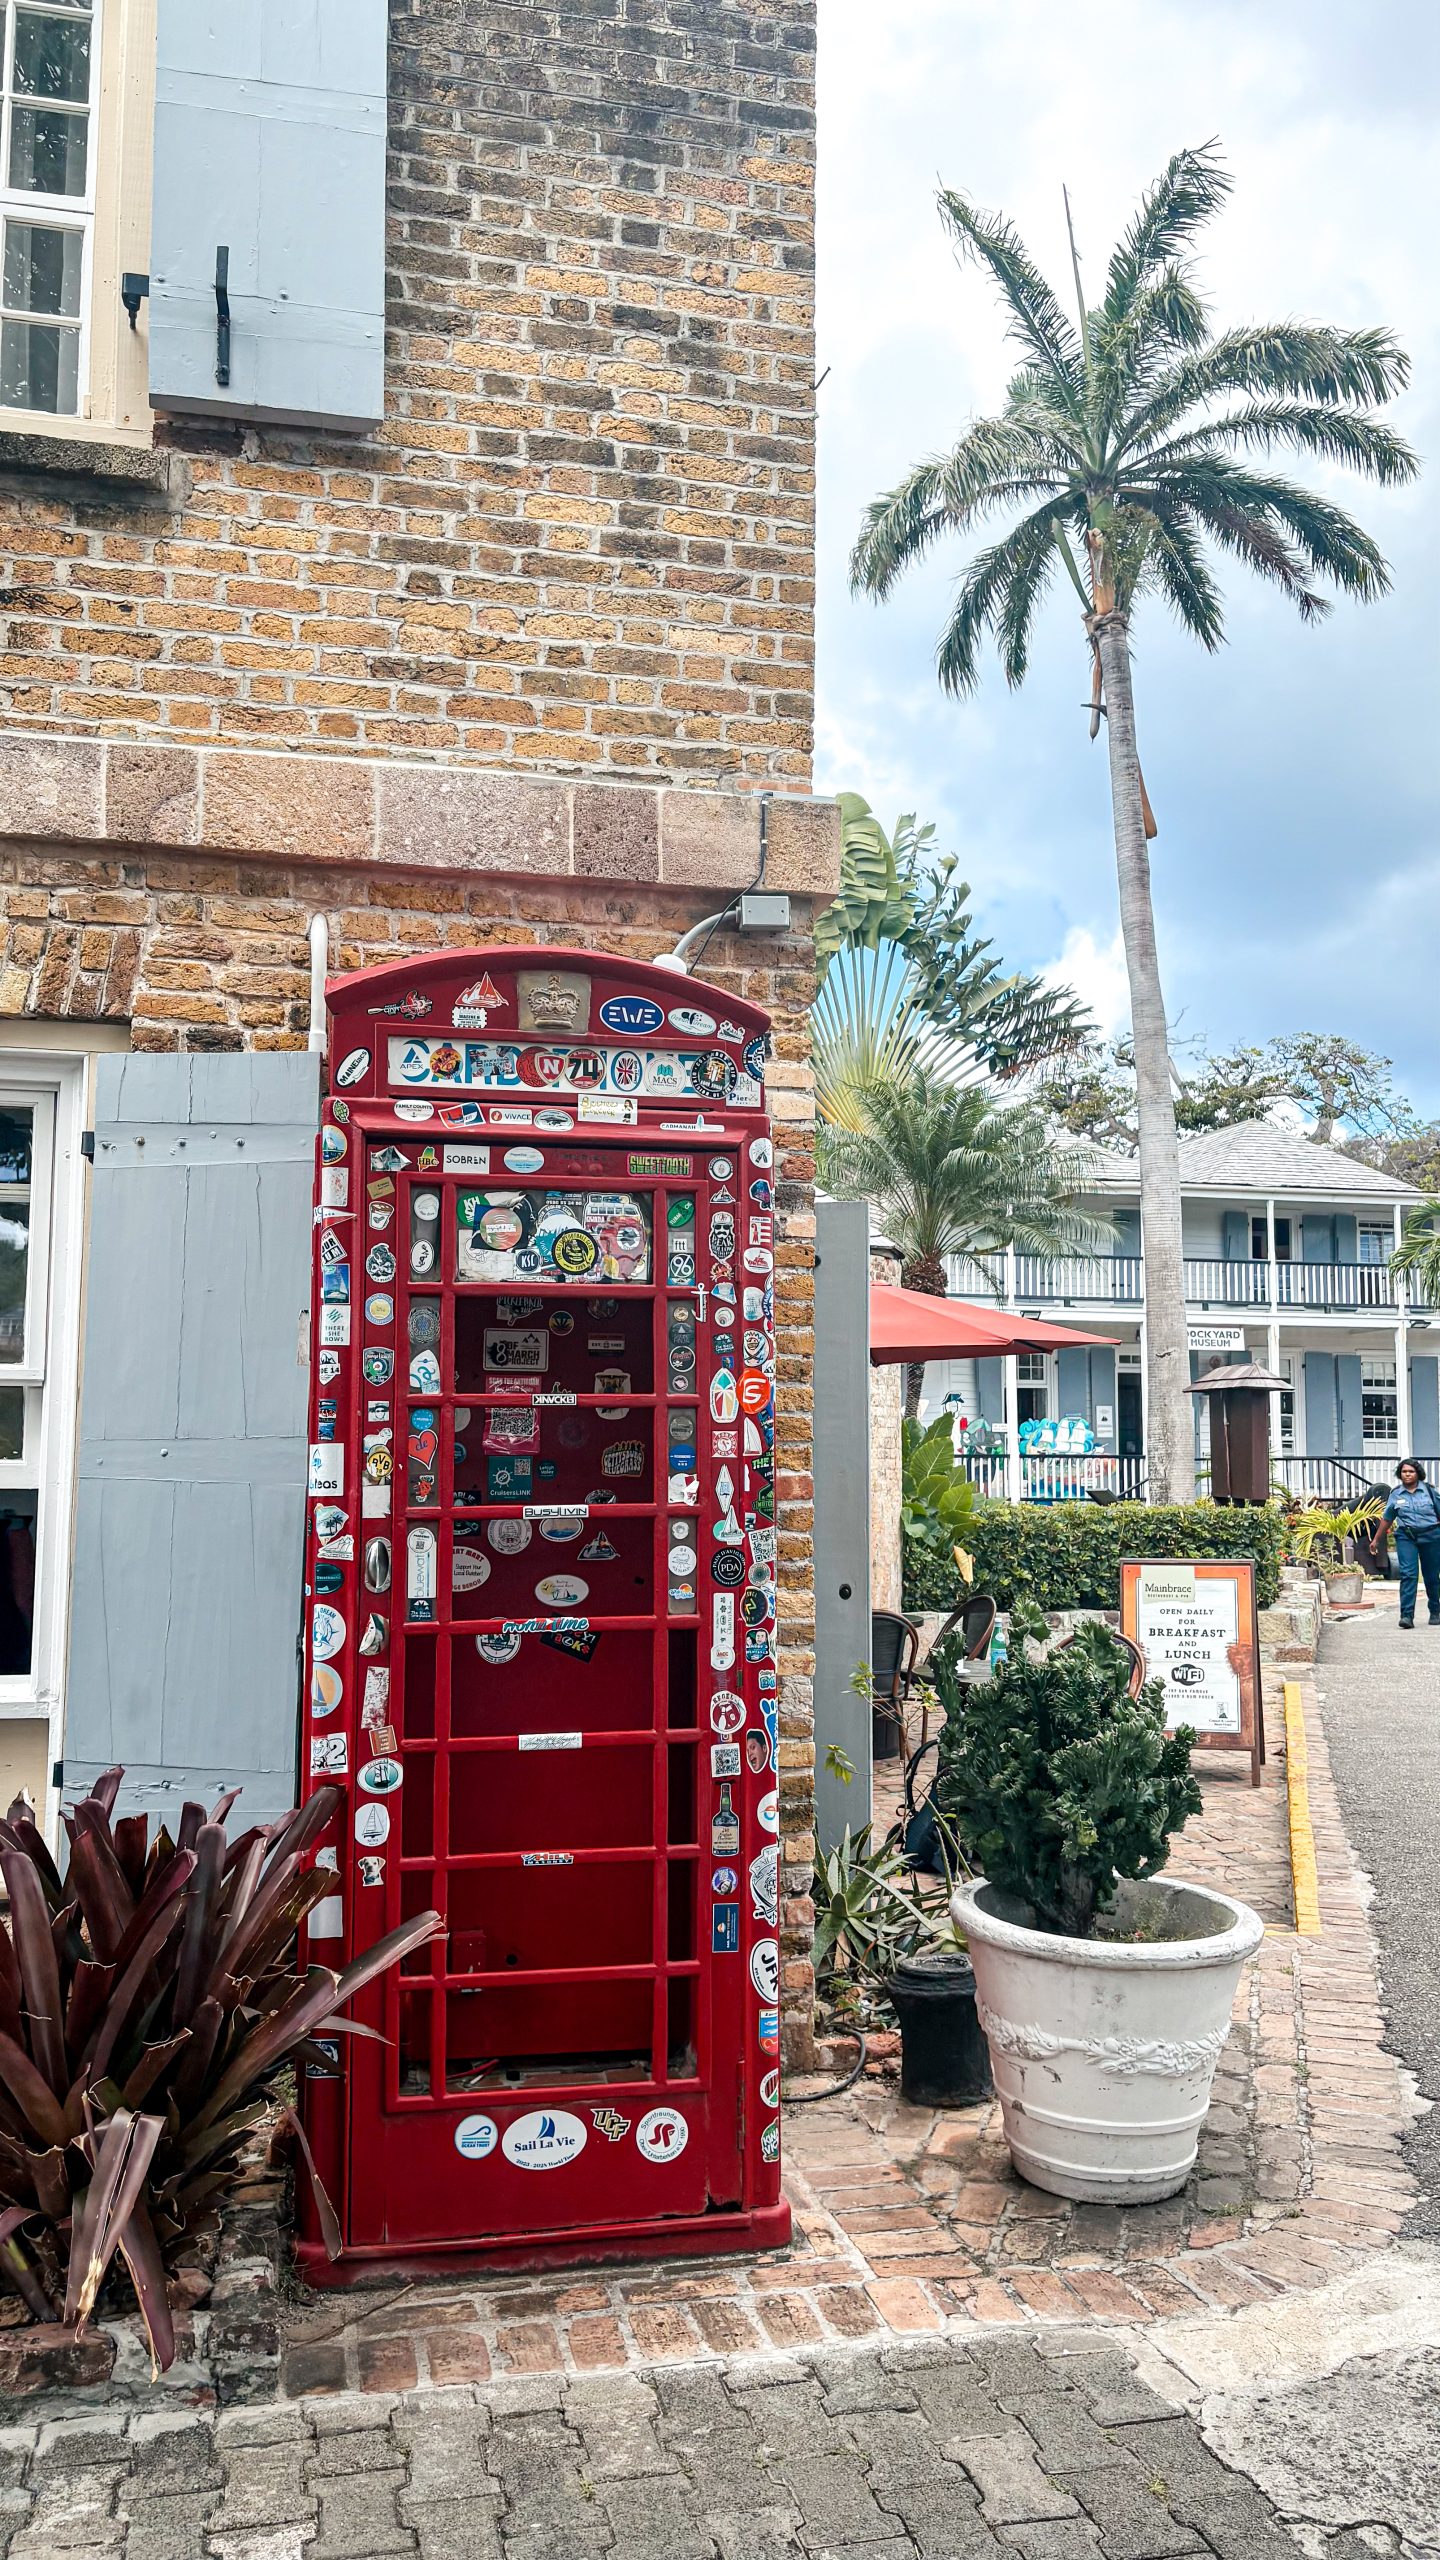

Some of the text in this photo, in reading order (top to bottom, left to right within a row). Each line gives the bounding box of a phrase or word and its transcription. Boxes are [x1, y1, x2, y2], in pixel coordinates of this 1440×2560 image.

[608, 1006, 656, 1025] EWE
[569, 1057, 599, 1080] 74
[652, 1075, 678, 1084] MACS
[728, 1092, 748, 1102] Pier
[418, 1157, 438, 1166] HBC
[446, 1155, 487, 1166] SOBREN
[521, 1254, 535, 1268] KSC
[1190, 1338, 1231, 1347] MUSEUM
[507, 1350, 541, 1360] MARCH
[507, 1358, 540, 1366] PROJECT
[720, 1563, 740, 1572] PDA
[1144, 1583, 1192, 1593] Mainbrace
[319, 1607, 337, 1619] DREAM
[1148, 1627, 1226, 1638] BREAKFAST
[1164, 1650, 1211, 1660] LUNCH
[594, 2109, 629, 2139] UCF
[514, 2136, 576, 2152] Sail La Vie
[548, 2159, 563, 2168] World
[562, 2152, 575, 2162] Tour
